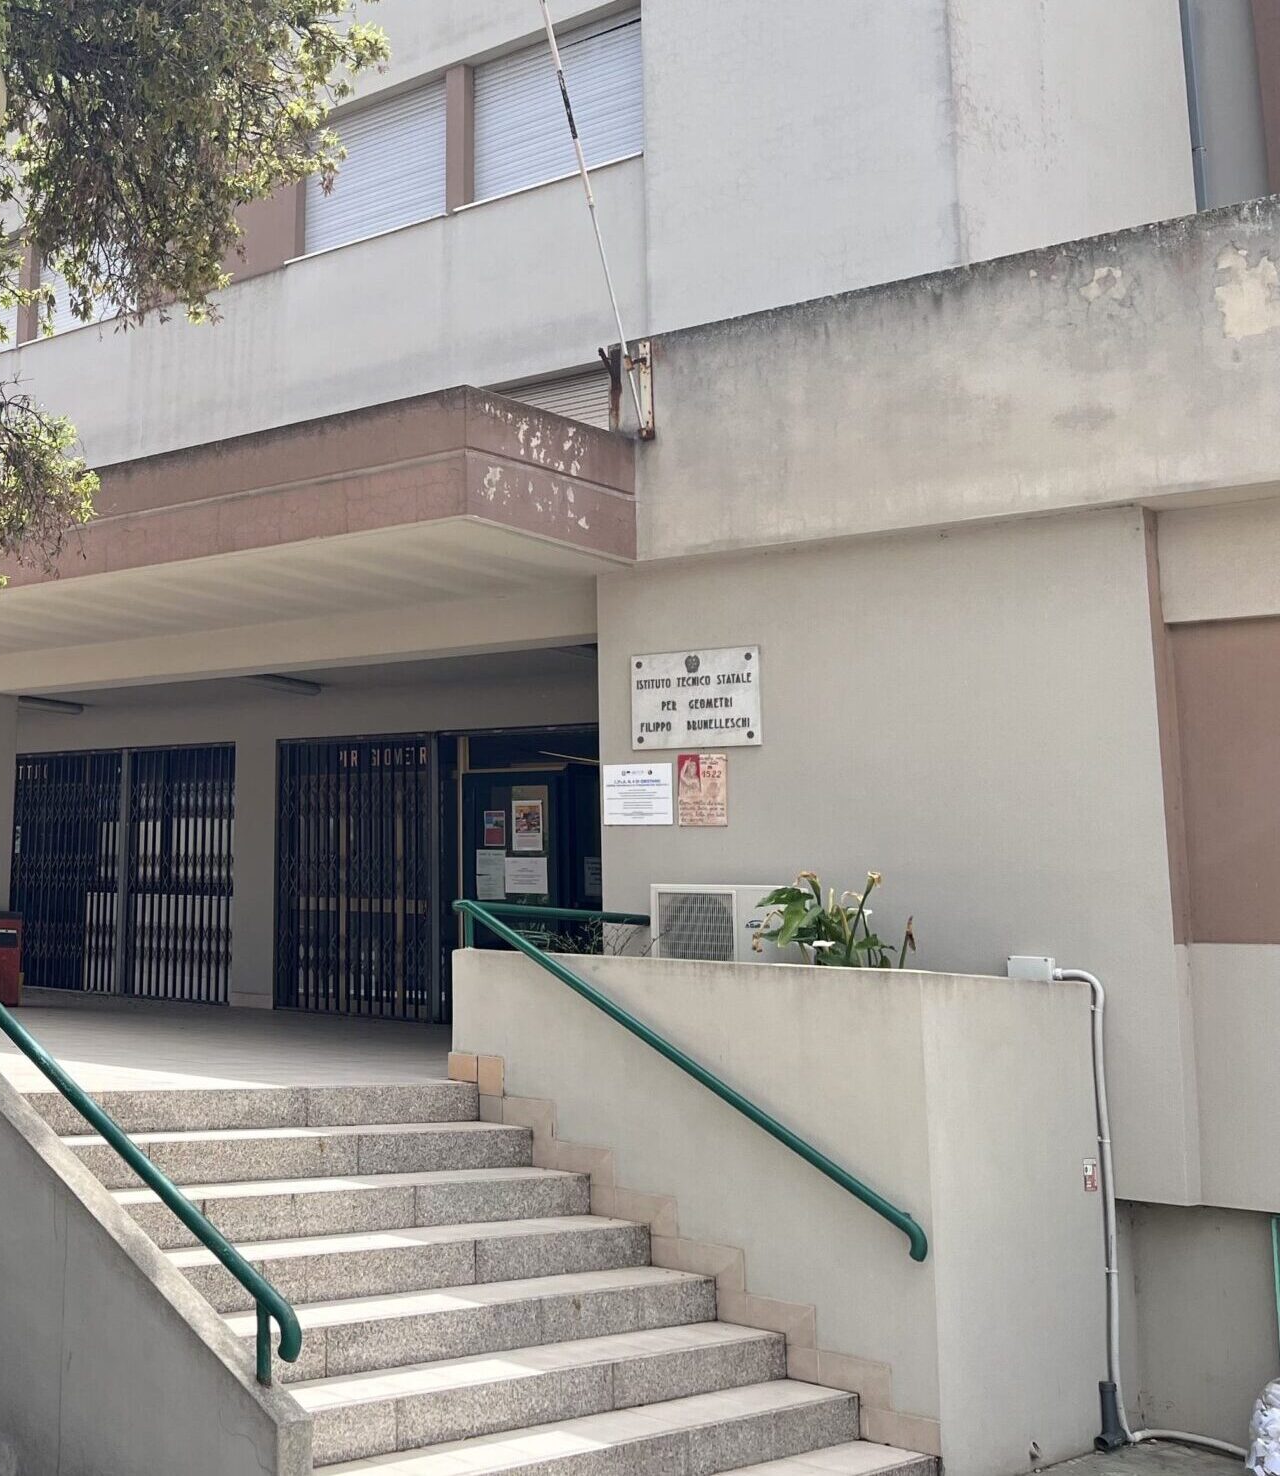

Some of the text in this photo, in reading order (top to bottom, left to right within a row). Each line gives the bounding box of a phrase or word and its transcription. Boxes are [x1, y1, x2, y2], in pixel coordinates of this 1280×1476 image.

[636, 672, 752, 690] ISTITUTO TECNICO STATALE
[661, 696, 733, 711] PER GEOMETRI
[640, 717, 750, 733] FILIPPO BRUNELLESCHI
[703, 770, 722, 779] 1522
